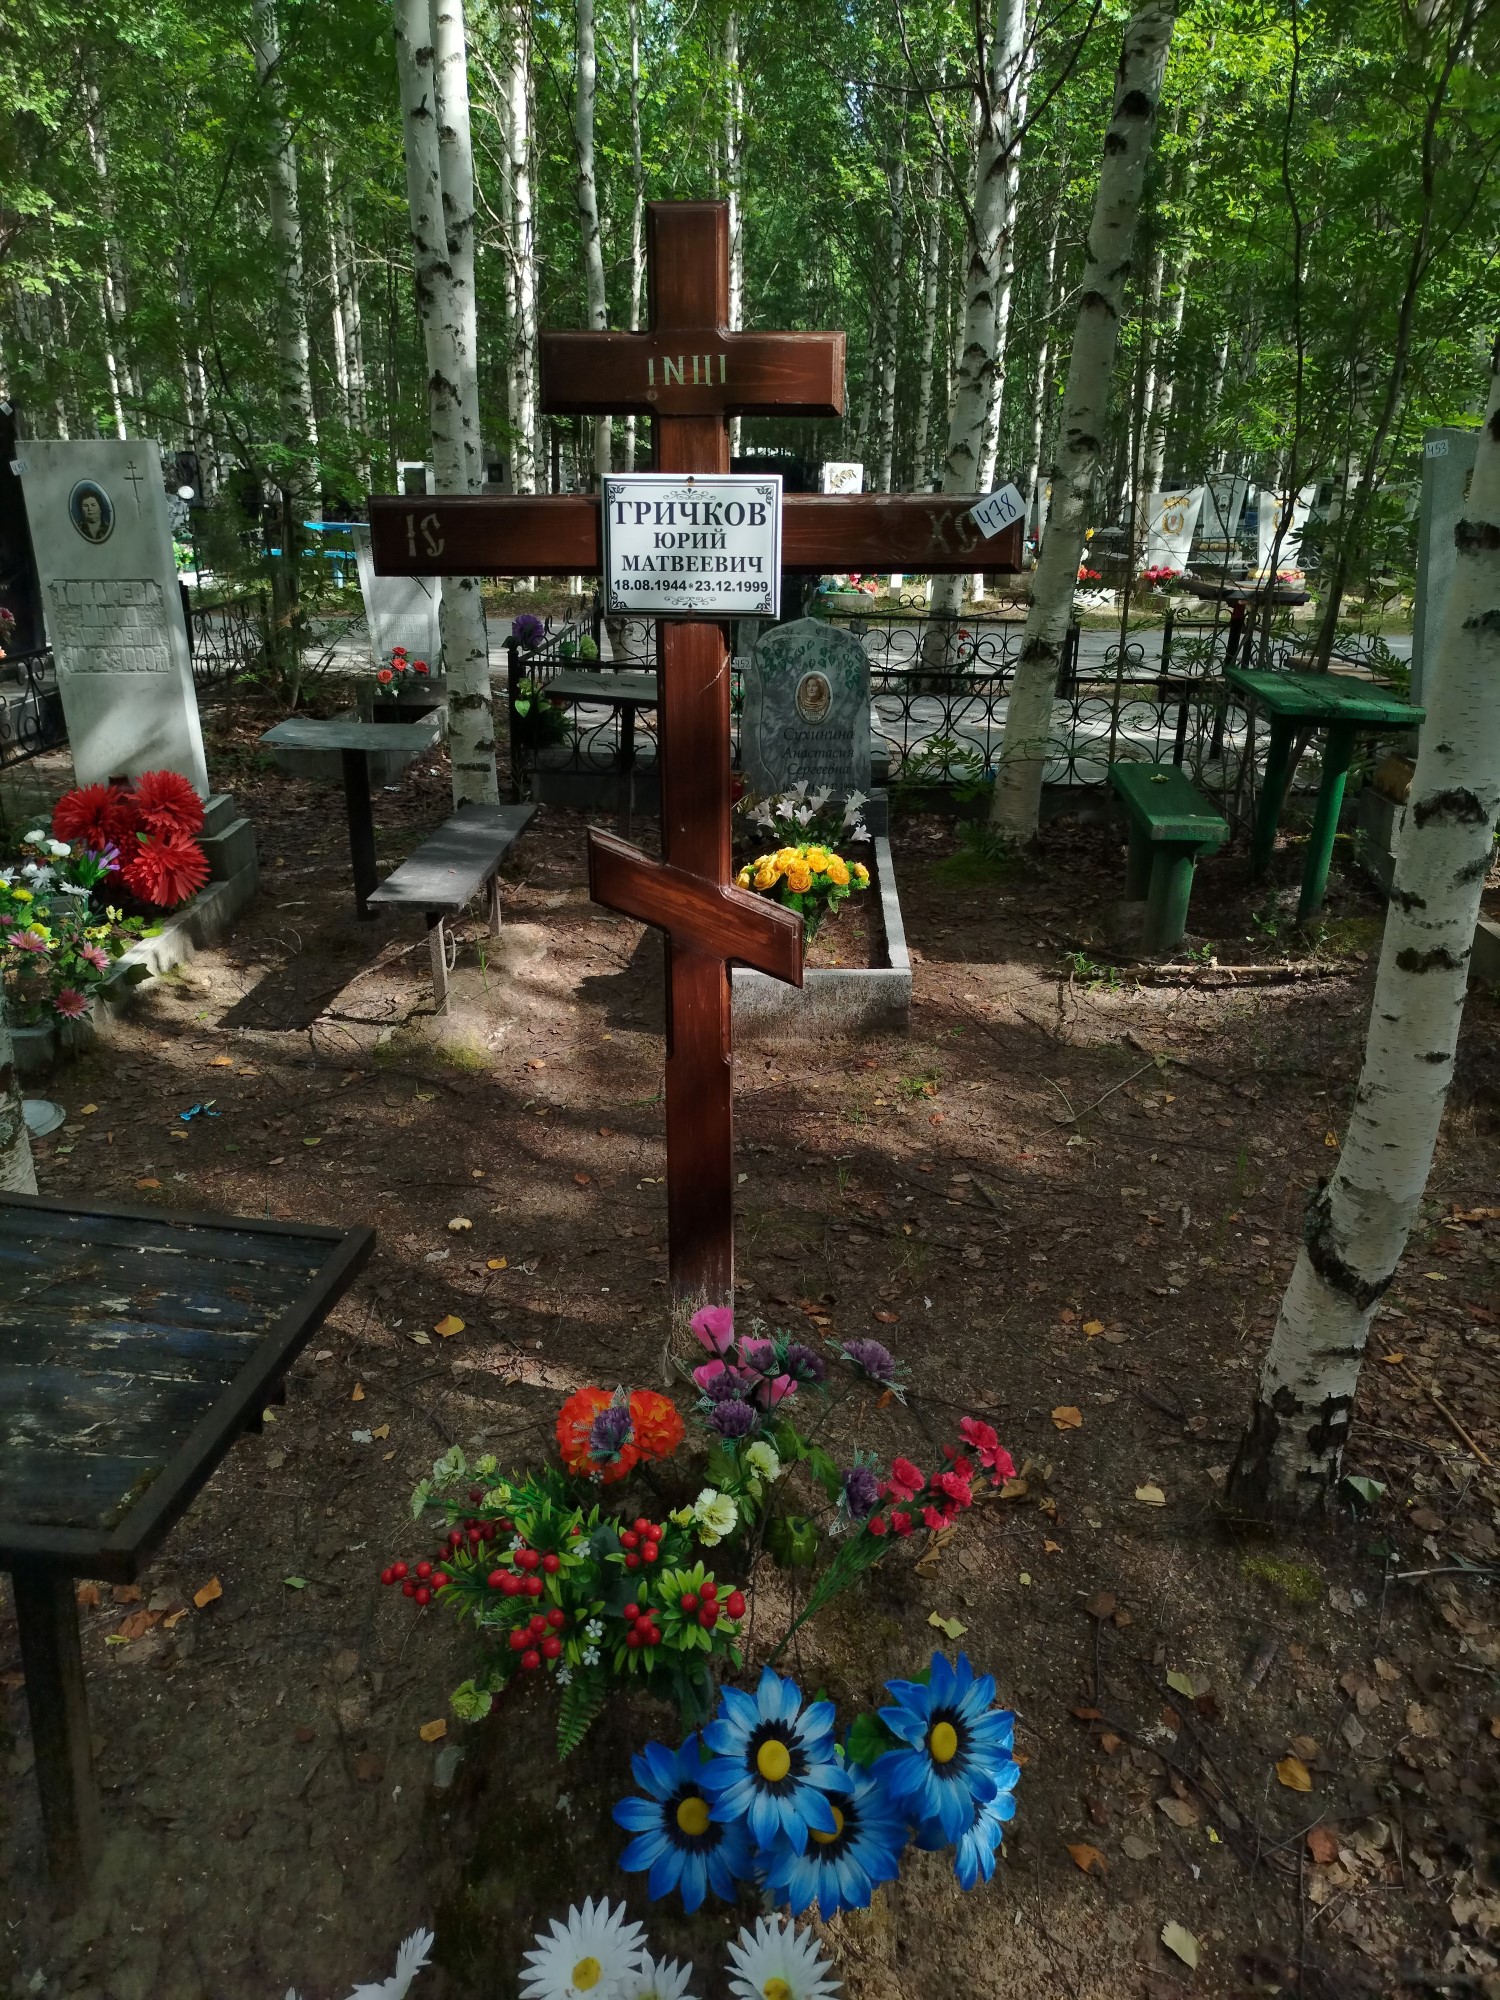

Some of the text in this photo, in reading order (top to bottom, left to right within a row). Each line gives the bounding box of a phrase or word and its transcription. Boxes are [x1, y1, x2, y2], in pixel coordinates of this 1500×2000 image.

[1427, 442, 1447, 455] 453
[615, 501, 768, 527] ГРИЧКОВ
[976, 492, 1017, 529] 478
[653, 528, 727, 549] ЮРИЙ
[621, 555, 764, 573] МАТВЕЕВИЧ
[53, 580, 160, 605] ТОКАРЕВА
[614, 579, 769, 592] 18.08.1944 23.12.1999
[82, 604, 139, 627] МАРИЯ
[783, 727, 854, 744] Сухинина
[781, 747, 854, 759] Анастасия
[787, 762, 853, 777] Сергеевна
